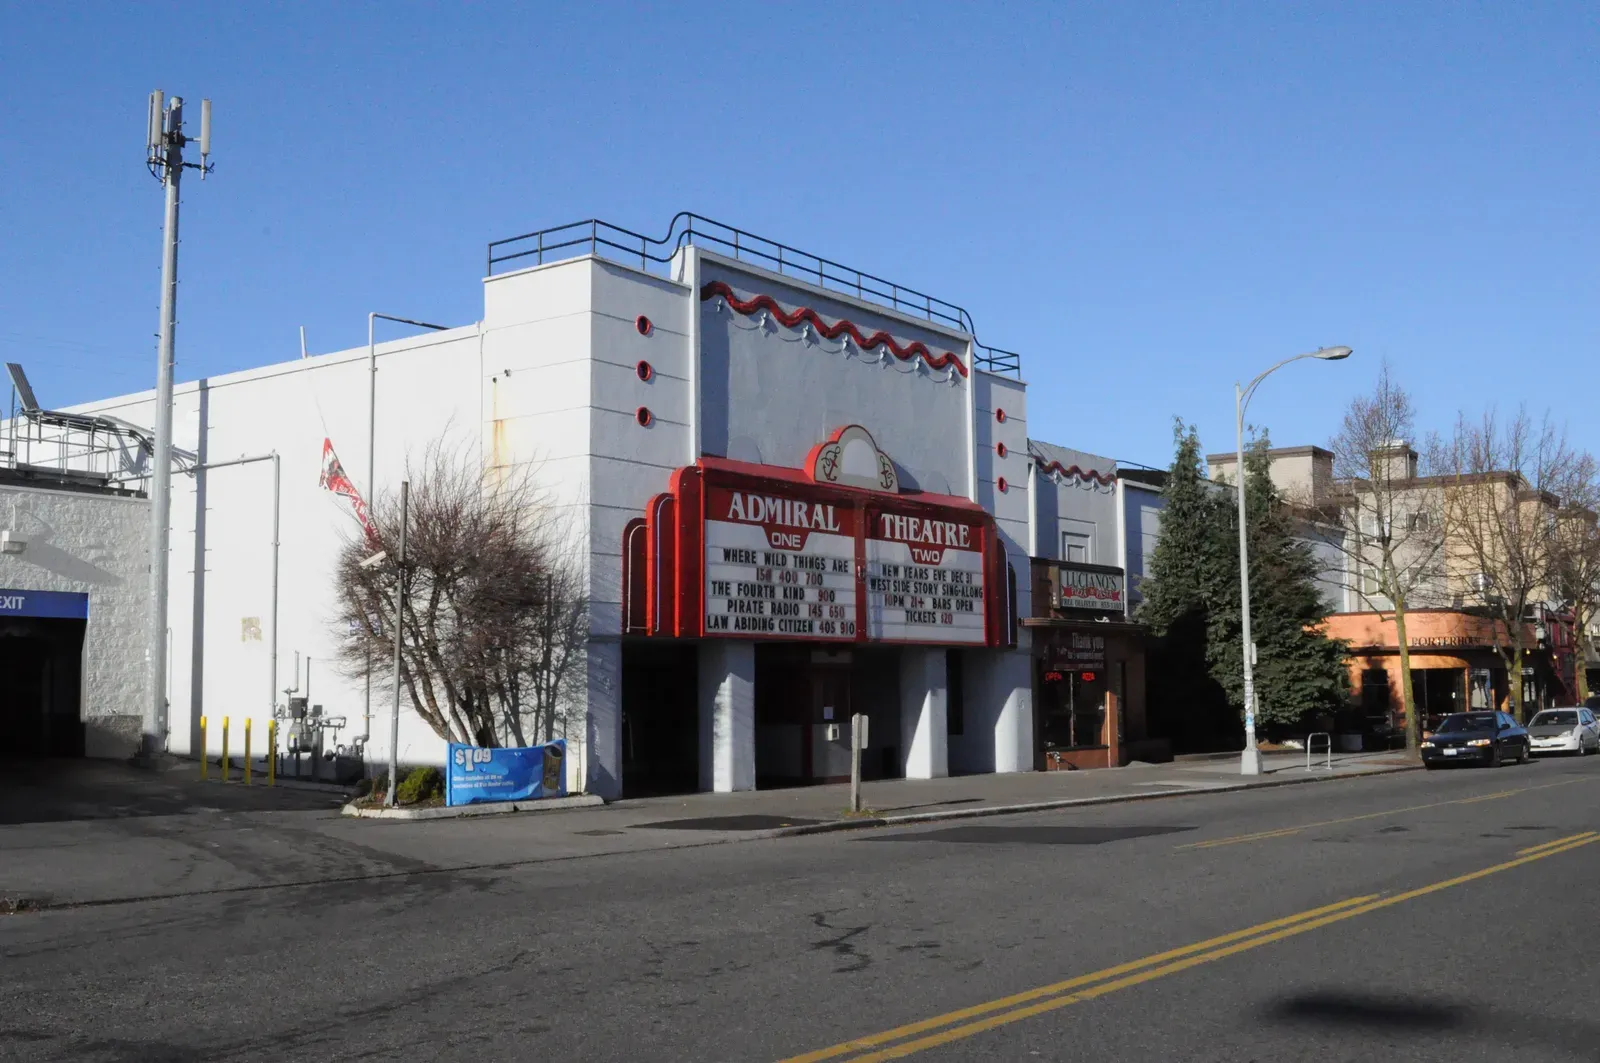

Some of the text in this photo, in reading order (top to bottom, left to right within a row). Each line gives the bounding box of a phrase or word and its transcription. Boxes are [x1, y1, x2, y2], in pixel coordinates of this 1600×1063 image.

[727, 492, 840, 532] ADMIRAL
[881, 513, 970, 548] THEATRE
[772, 532, 800, 548] ONE
[723, 549, 848, 572] WHERE WILD THINGS ARE
[912, 548, 940, 562] TWO
[778, 571, 798, 584] 400
[806, 573, 823, 586] 700
[882, 564, 972, 584] NEW YEARS EVE DEC 31
[1066, 571, 1116, 590] LUCIANO'S
[712, 581, 835, 602] THE FOURTH KIND 900
[870, 579, 982, 598] WEST SIDE STORY SING-ALONG
[1072, 587, 1088, 598] PIZZA
[1096, 588, 1112, 599] PASTA
[728, 600, 844, 618] PIRATE RADIO 145 650
[884, 594, 974, 612] 10PM 21+ BARS OPEN
[708, 616, 854, 634] LAW ABIDING CITIZEN 405 910
[906, 610, 953, 624] TICKETS $20
[1072, 632, 1104, 652] Thank you
